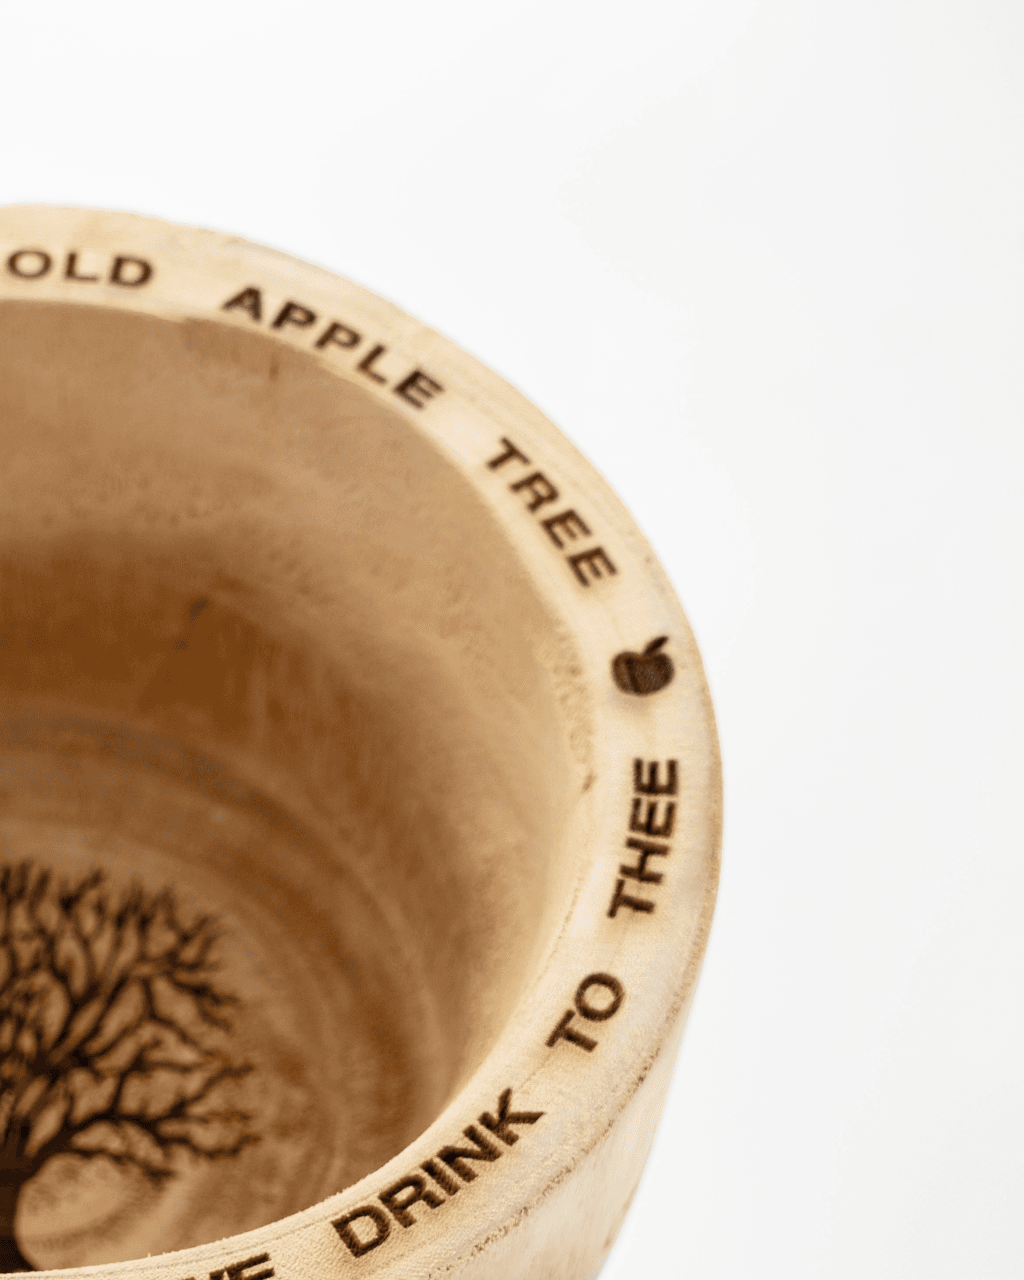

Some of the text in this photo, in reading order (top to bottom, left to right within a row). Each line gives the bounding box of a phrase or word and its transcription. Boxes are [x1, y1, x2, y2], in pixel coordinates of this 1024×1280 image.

[5, 248, 155, 289] OLD
[221, 285, 446, 411] APPLE
[484, 436, 619, 589] TREE
[330, 1087, 548, 1259] DRINK
[545, 971, 626, 1054] TO
[607, 756, 679, 920] THEE
